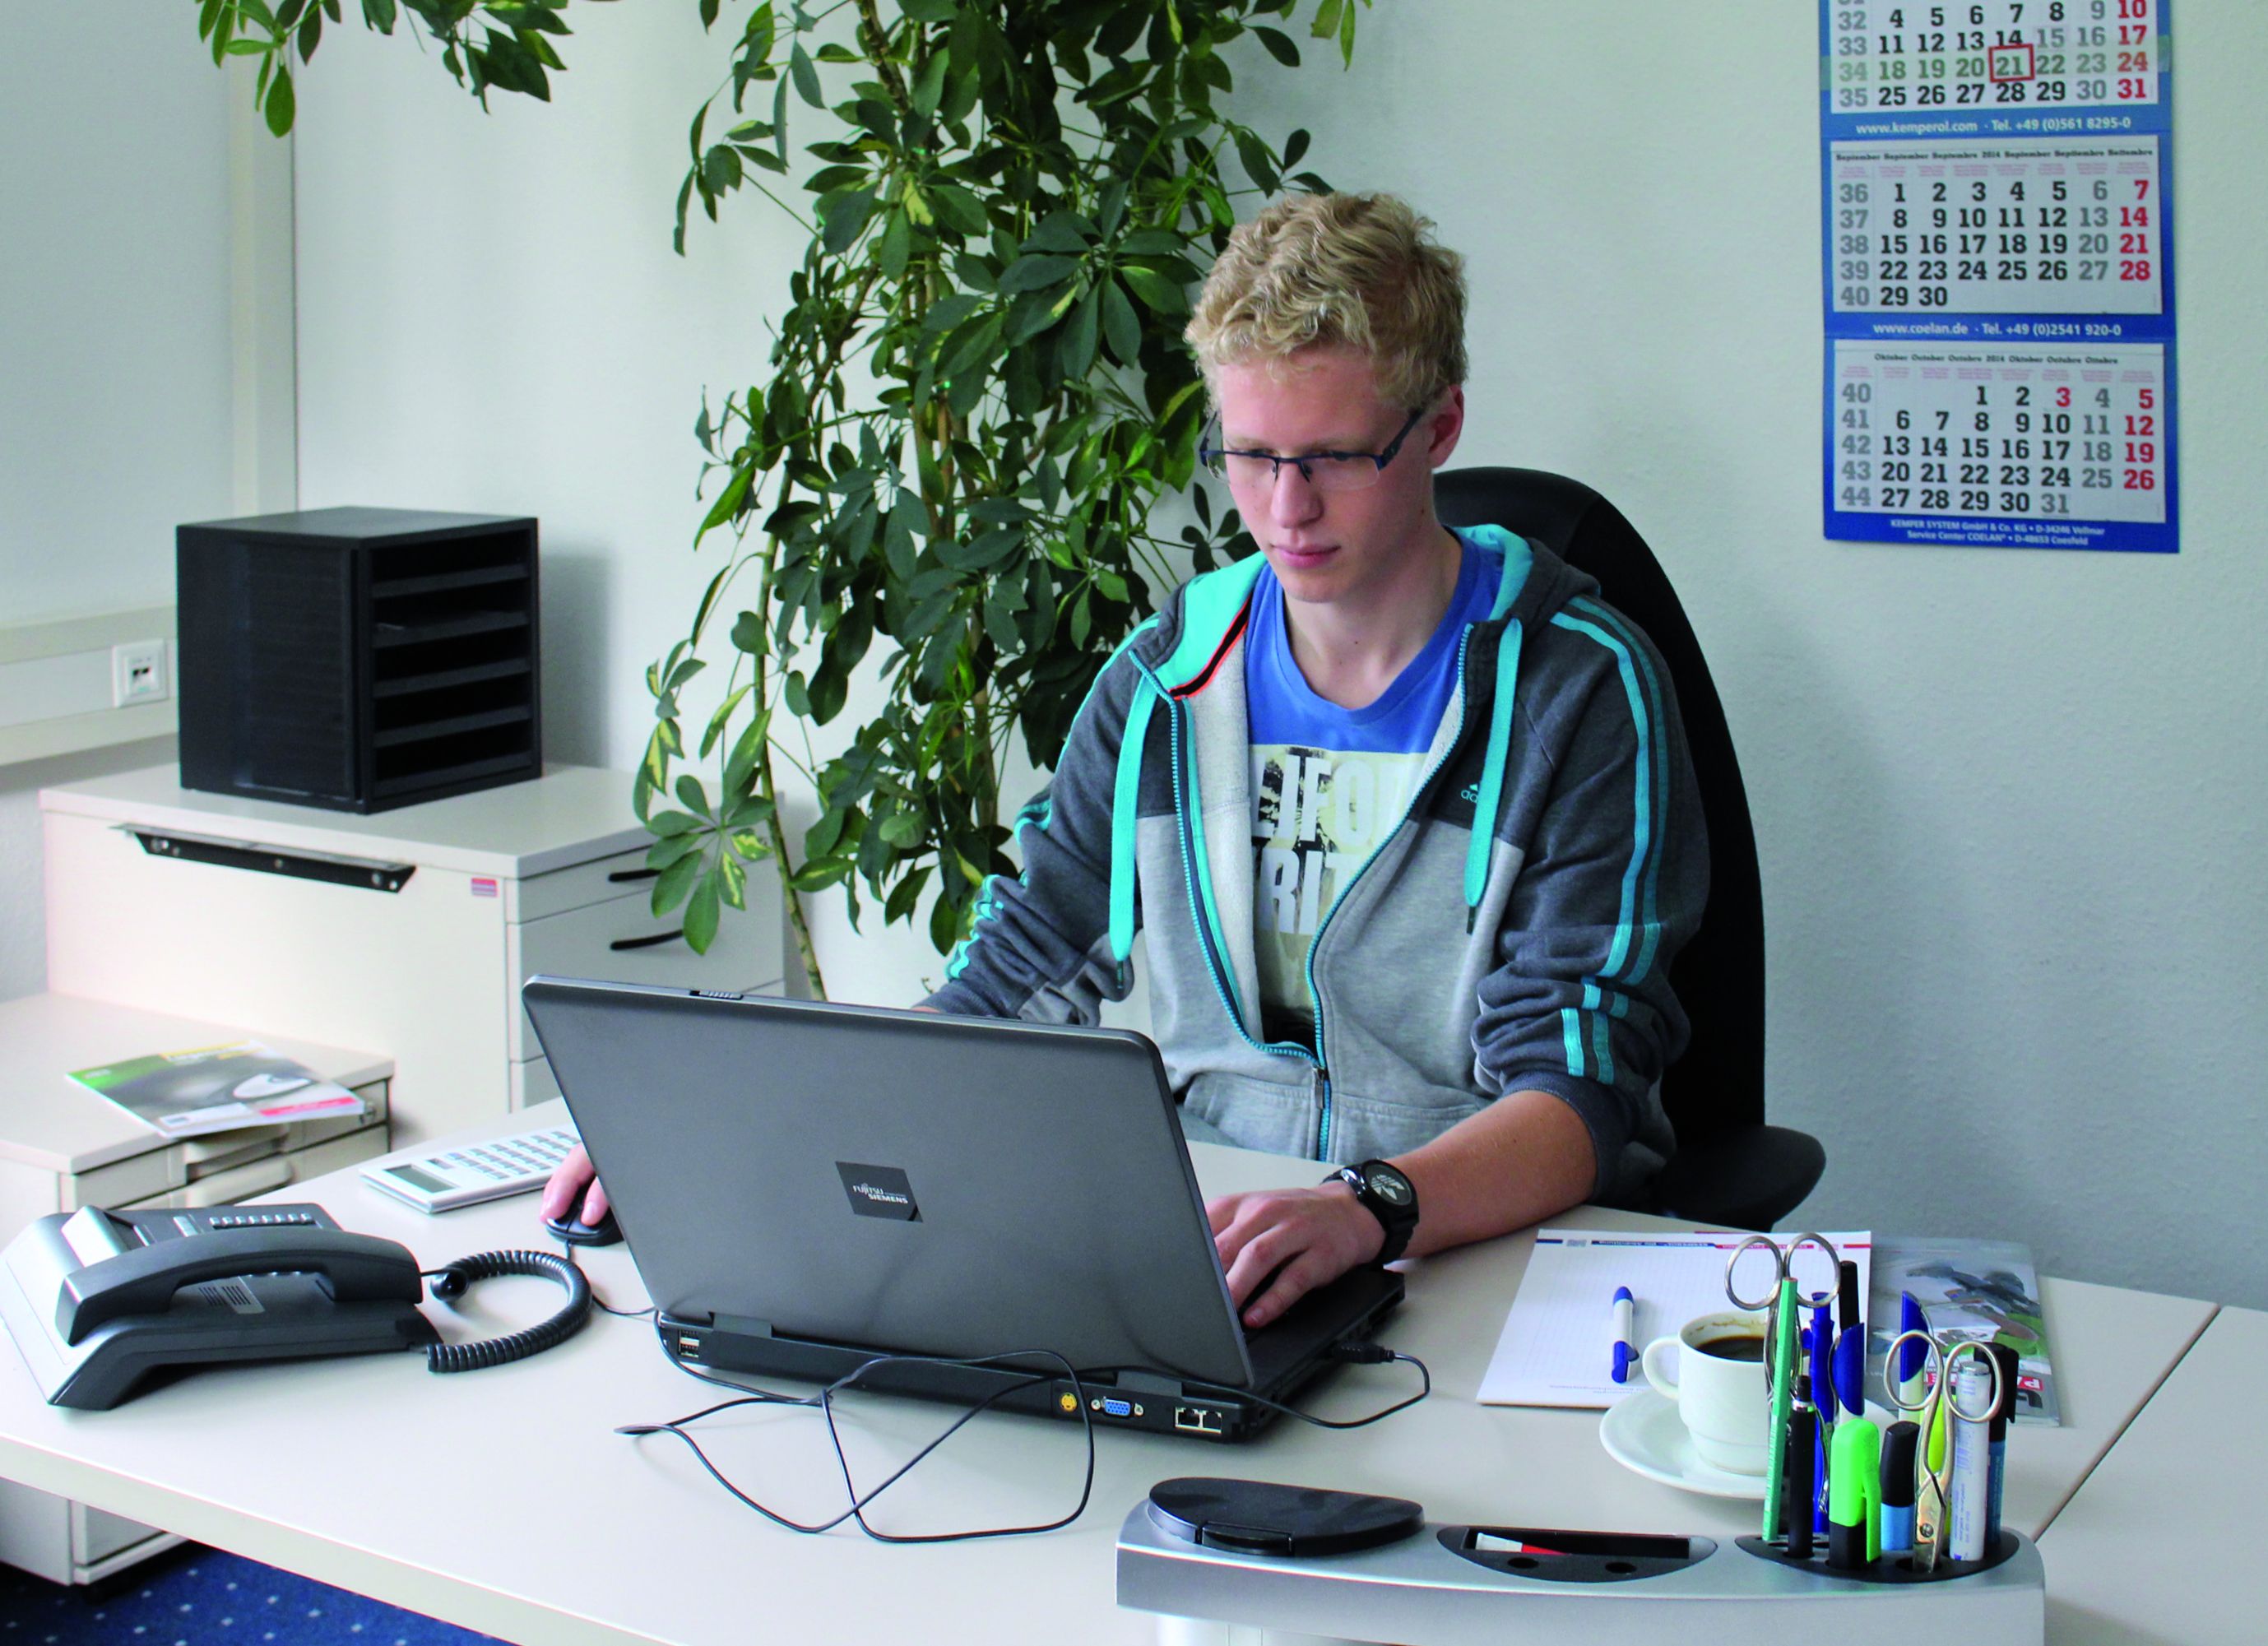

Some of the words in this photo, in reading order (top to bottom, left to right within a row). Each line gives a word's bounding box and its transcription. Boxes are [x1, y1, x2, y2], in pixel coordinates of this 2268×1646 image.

[1838, 10, 1867, 32] 32
[1889, 9, 1904, 29] 4
[1931, 7, 1944, 27] 5
[1969, 5, 1984, 26] 6
[2009, 3, 2024, 24] 7
[2049, 1, 2065, 22] 8
[2090, 0, 2105, 21] 9
[2117, 0, 2147, 19] 10
[1838, 35, 1867, 57] 33
[1879, 35, 1904, 55] 11
[1918, 32, 1945, 53] 12
[1957, 30, 1985, 52] 13
[1996, 30, 2024, 47] 14
[2036, 28, 2066, 49] 15
[2077, 26, 2106, 48] 16
[2118, 24, 2148, 46] 17
[1839, 61, 1868, 83] 34
[1879, 60, 1907, 81] 18
[1918, 58, 1946, 80] 19
[1955, 57, 1985, 78] 20
[1995, 56, 2025, 77] 21
[2035, 54, 2066, 75] 22
[2076, 52, 2107, 74] 23
[2117, 51, 2149, 73] 24
[1839, 87, 1868, 109] 35
[1878, 86, 1907, 106] 25
[1917, 84, 1946, 105] 26
[1956, 83, 1985, 104] 27
[1996, 82, 2026, 103] 28
[2036, 81, 2066, 102] 29
[2076, 79, 2107, 101] 30
[2117, 78, 2146, 100] 31
[1856, 121, 1978, 135] www.kemperol.com
[1992, 119, 2012, 132] Tel.
[2015, 118, 2039, 131] +49
[2043, 118, 2083, 132] (0)561
[2086, 117, 2131, 129] 8295-0
[1839, 183, 1869, 204] 36
[1895, 183, 1906, 203] 1
[1932, 182, 1946, 202] 2
[1972, 181, 1987, 202] 3
[2010, 181, 2025, 202] 4
[2052, 180, 2067, 202] 5
[2093, 179, 2108, 202] 6
[2134, 179, 2150, 201] 7
[1839, 209, 1869, 230] 37
[1893, 208, 1908, 229] 8
[1932, 208, 1947, 229] 9
[1959, 207, 1987, 229] 10
[1998, 207, 2025, 228] 11
[2038, 206, 2067, 228] 12
[2080, 206, 2108, 228] 13
[2120, 206, 2149, 228] 14
[1839, 234, 1870, 255] 38
[1881, 234, 1908, 255] 15
[1919, 234, 1947, 255] 16
[1959, 234, 1987, 254] 17
[1998, 234, 2027, 254] 18
[2039, 233, 2067, 254] 19
[2078, 233, 2108, 254] 20
[2119, 233, 2149, 254] 21
[1840, 260, 1870, 281] 39
[1879, 260, 1908, 281] 22
[1918, 260, 1947, 281] 23
[1958, 260, 1987, 281] 24
[1997, 260, 2028, 281] 25
[2038, 260, 2068, 281] 26
[2078, 260, 2108, 281] 27
[2119, 259, 2151, 281] 28
[1840, 285, 1870, 307] 40
[1880, 285, 1909, 307] 29
[1918, 286, 1948, 307] 30
[1872, 322, 1969, 335] www.coelan.de
[1981, 322, 2002, 335] Tel.
[2006, 323, 2030, 335] +49
[2033, 322, 2081, 336] (0)2541
[2085, 323, 2122, 336] 920-0
[1841, 383, 1871, 404] 40
[1976, 385, 1988, 406] 1
[2015, 386, 2030, 406] 2
[2056, 387, 2071, 408] 3
[2094, 387, 2110, 409] 4
[2139, 388, 2154, 410] 5
[1841, 408, 1870, 429] 41
[1896, 410, 1910, 430] 6
[1935, 410, 1950, 431] 7
[1973, 411, 1990, 432] 8
[2015, 412, 2030, 434] 9
[2042, 413, 2071, 434] 10
[2083, 414, 2111, 435] 11
[2125, 415, 2154, 437] 12
[1841, 434, 1871, 455] 42
[1883, 435, 1910, 457] 13
[1921, 436, 1948, 457] 14
[1961, 438, 1989, 459] 15
[2001, 438, 2029, 460] 16
[2042, 440, 2071, 461] 17
[2083, 441, 2113, 462] 18
[2125, 442, 2154, 464] 19
[1841, 460, 1871, 481] 43
[1881, 461, 1910, 482] 20
[1920, 462, 1948, 484] 21
[1960, 464, 1989, 485] 22
[2000, 465, 2030, 486] 23
[2040, 466, 2071, 488] 24
[2081, 467, 2113, 489] 25
[2123, 468, 2155, 491] 26
[1841, 486, 1871, 508] 44
[1881, 487, 1910, 508] 27
[1920, 489, 1950, 510] 28
[1960, 489, 1990, 512] 29
[2000, 491, 2030, 512] 30
[2041, 493, 2070, 515] 31
[852, 1184, 884, 1195] FUJITSU
[868, 1194, 909, 1204] SIEMENS
